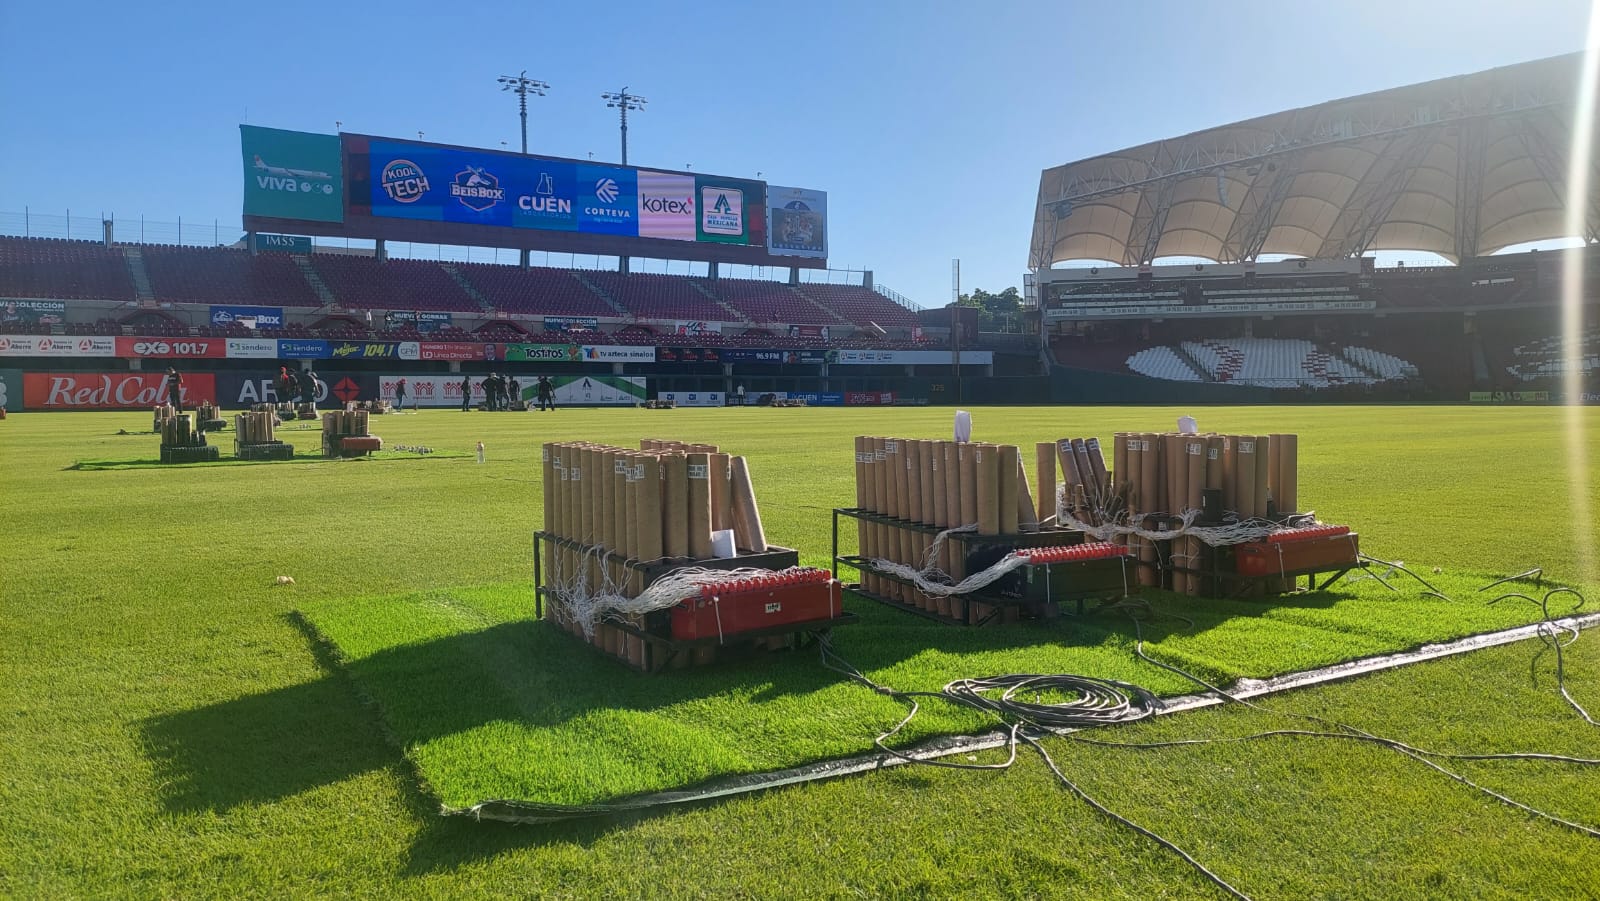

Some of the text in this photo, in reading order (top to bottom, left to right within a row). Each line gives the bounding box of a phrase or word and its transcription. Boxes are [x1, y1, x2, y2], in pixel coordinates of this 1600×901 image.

[387, 167, 416, 179] KOOL
[382, 177, 431, 198] TECH
[518, 195, 572, 214] CUÉN
[584, 207, 631, 218] CORTEVA
[266, 235, 295, 246] IMSS
[172, 343, 209, 355] 101.7
[241, 343, 273, 351] sendero
[292, 344, 323, 352] sendero
[362, 344, 395, 357] 104.1
[630, 351, 654, 359] sinaloa
[770, 352, 780, 360] FM
[44, 375, 111, 405] Red
